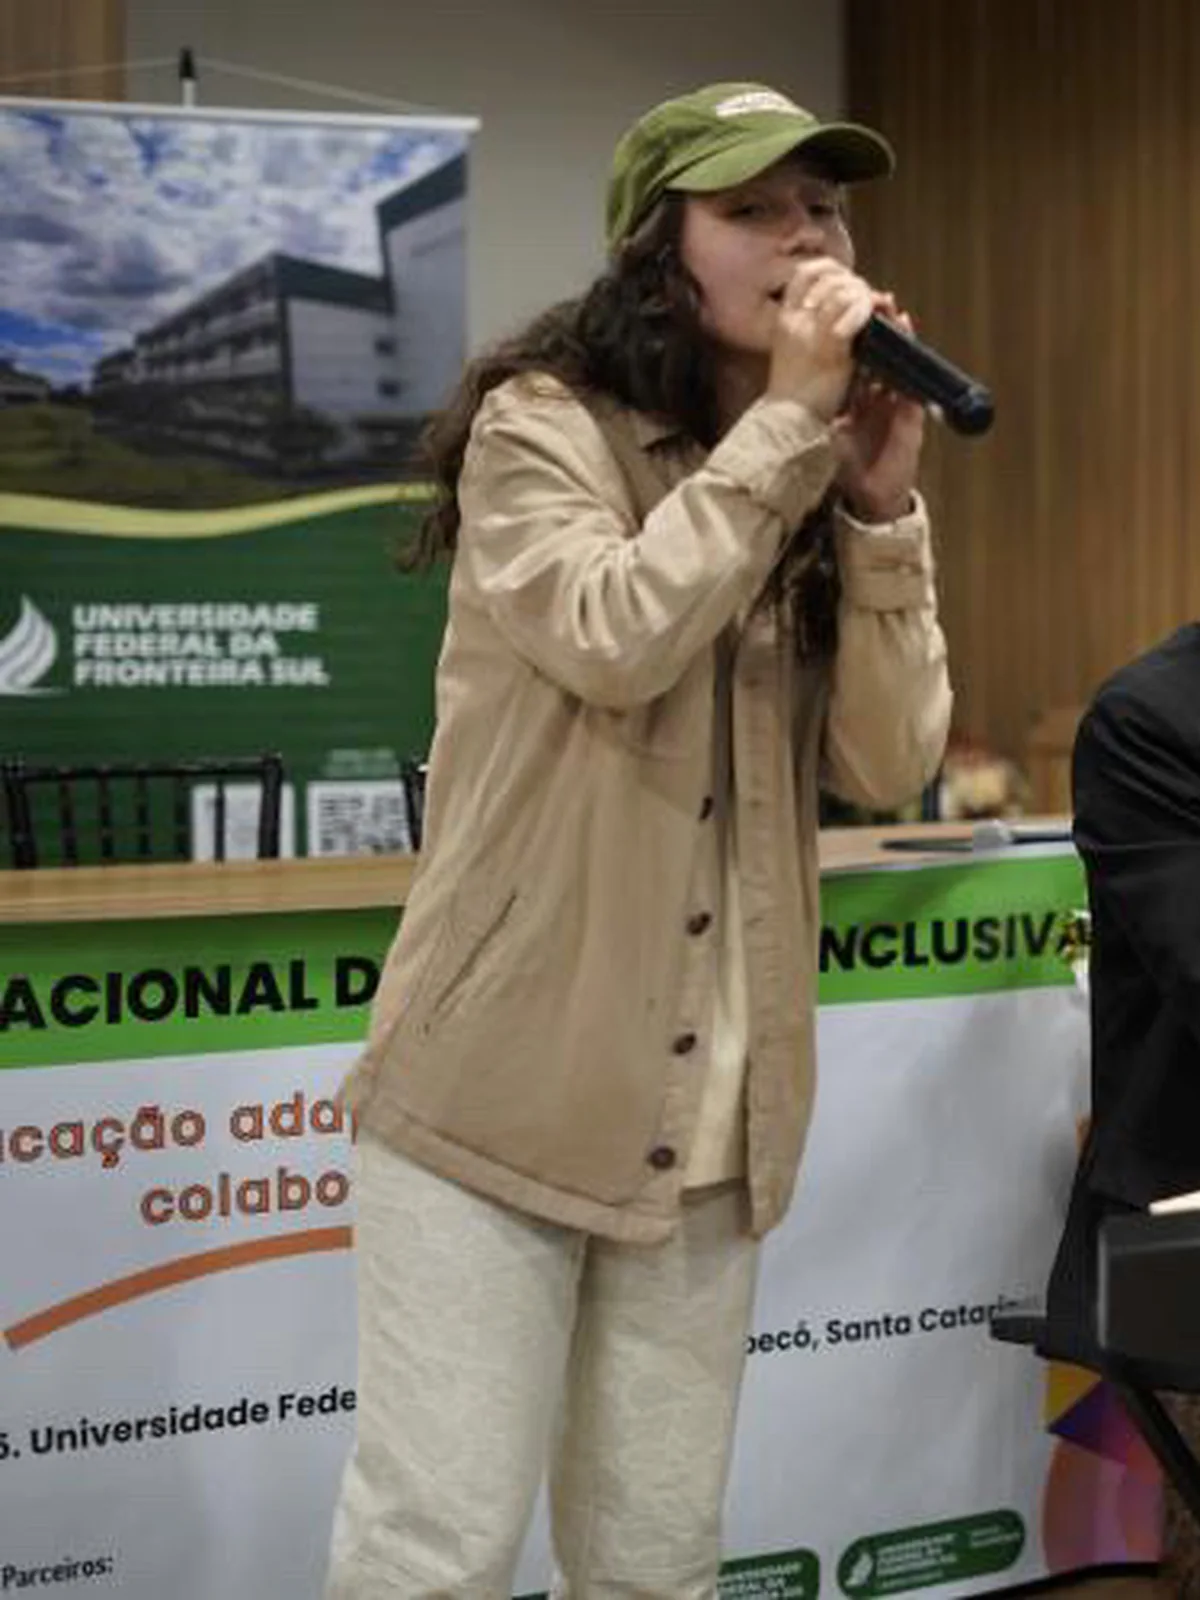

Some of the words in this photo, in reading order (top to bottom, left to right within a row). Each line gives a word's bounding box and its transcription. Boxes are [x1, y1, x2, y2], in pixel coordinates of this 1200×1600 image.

[73, 604, 319, 630] UNIVERSIDADE
[74, 632, 219, 657] FEDERAL
[229, 631, 280, 656] DA
[75, 659, 265, 686] FRONTEIRA
[270, 658, 330, 686] SUL
[825, 1313, 912, 1345] Santa
[30, 1397, 270, 1455] Universidade
[1, 1555, 114, 1589] Parceiros:
